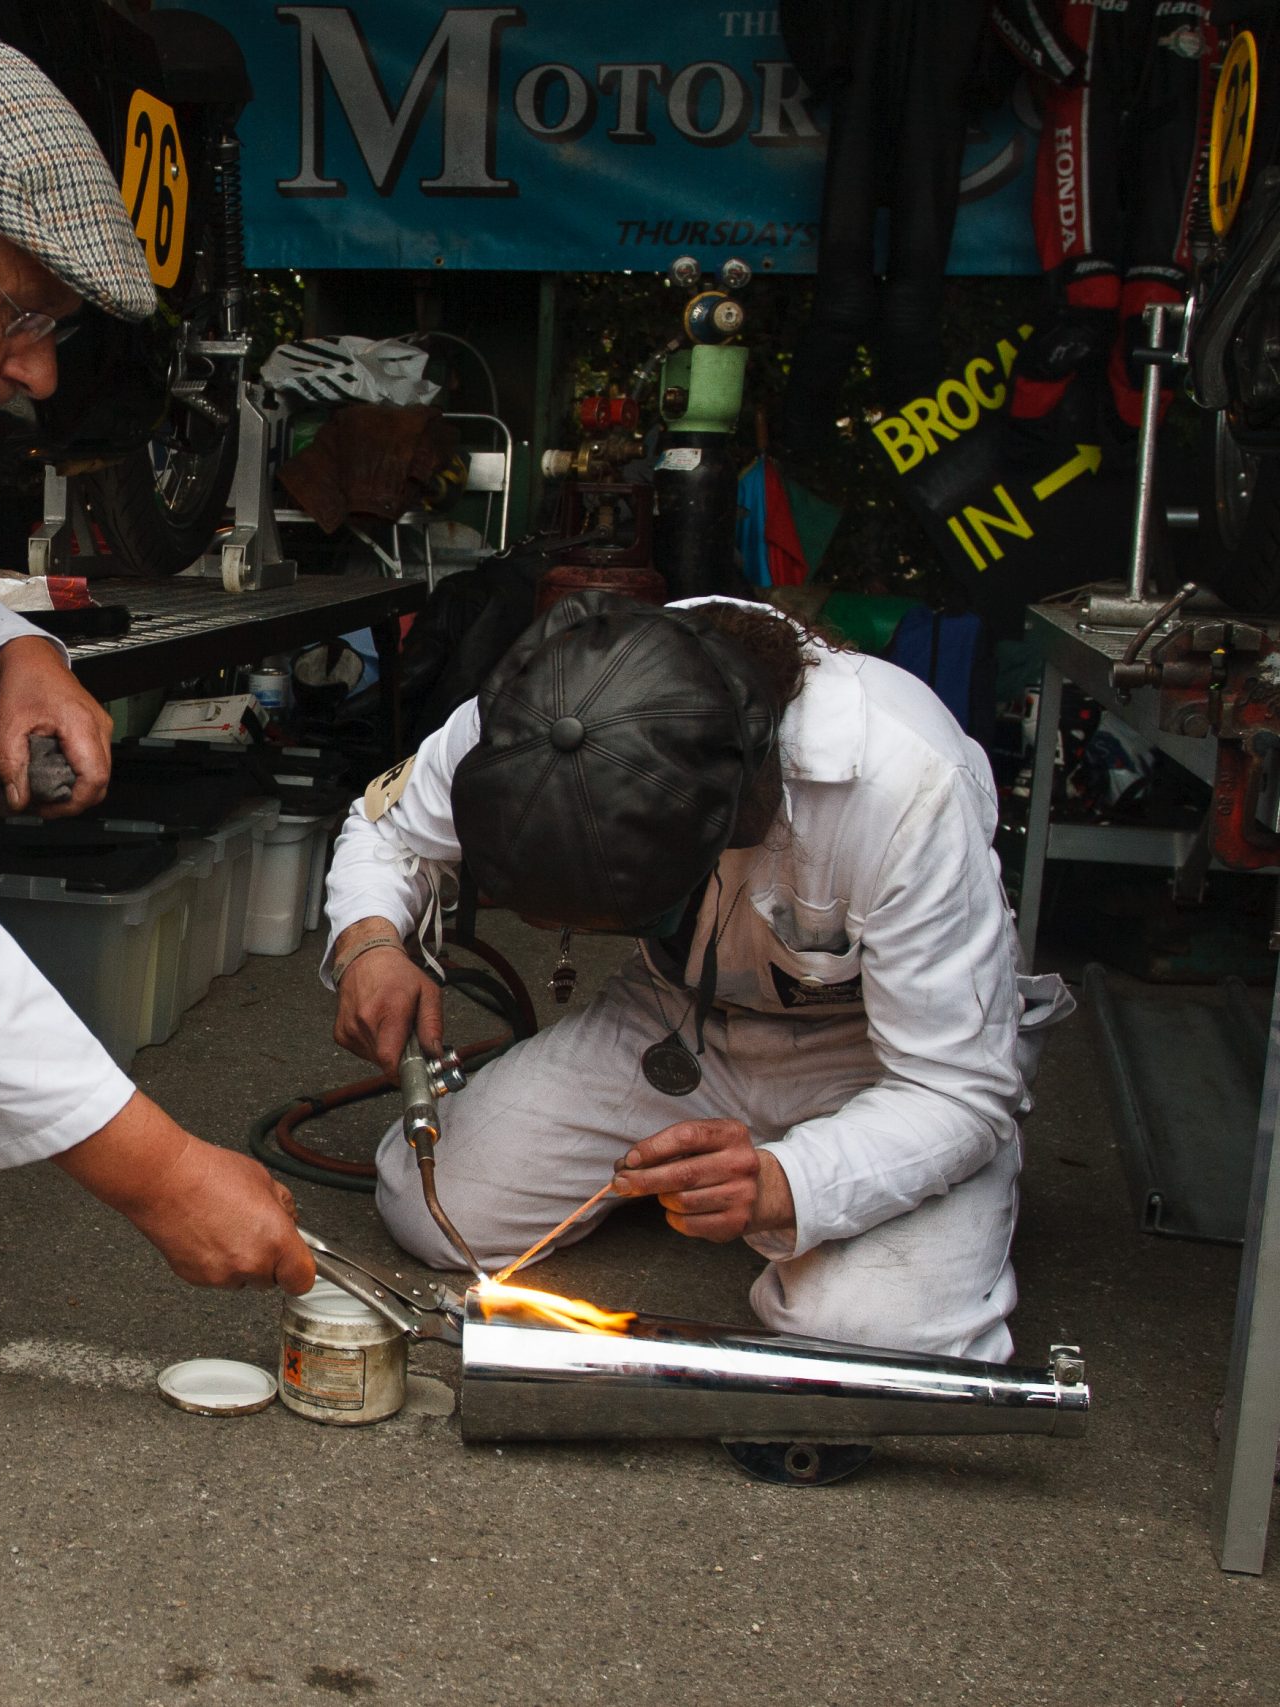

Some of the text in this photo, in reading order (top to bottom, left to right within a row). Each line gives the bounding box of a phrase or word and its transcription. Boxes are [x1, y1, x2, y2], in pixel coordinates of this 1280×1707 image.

[131, 111, 176, 267] 26
[617, 219, 818, 249] THURSDAYS
[1054, 124, 1077, 254] HONDA
[946, 483, 1035, 572] IN
